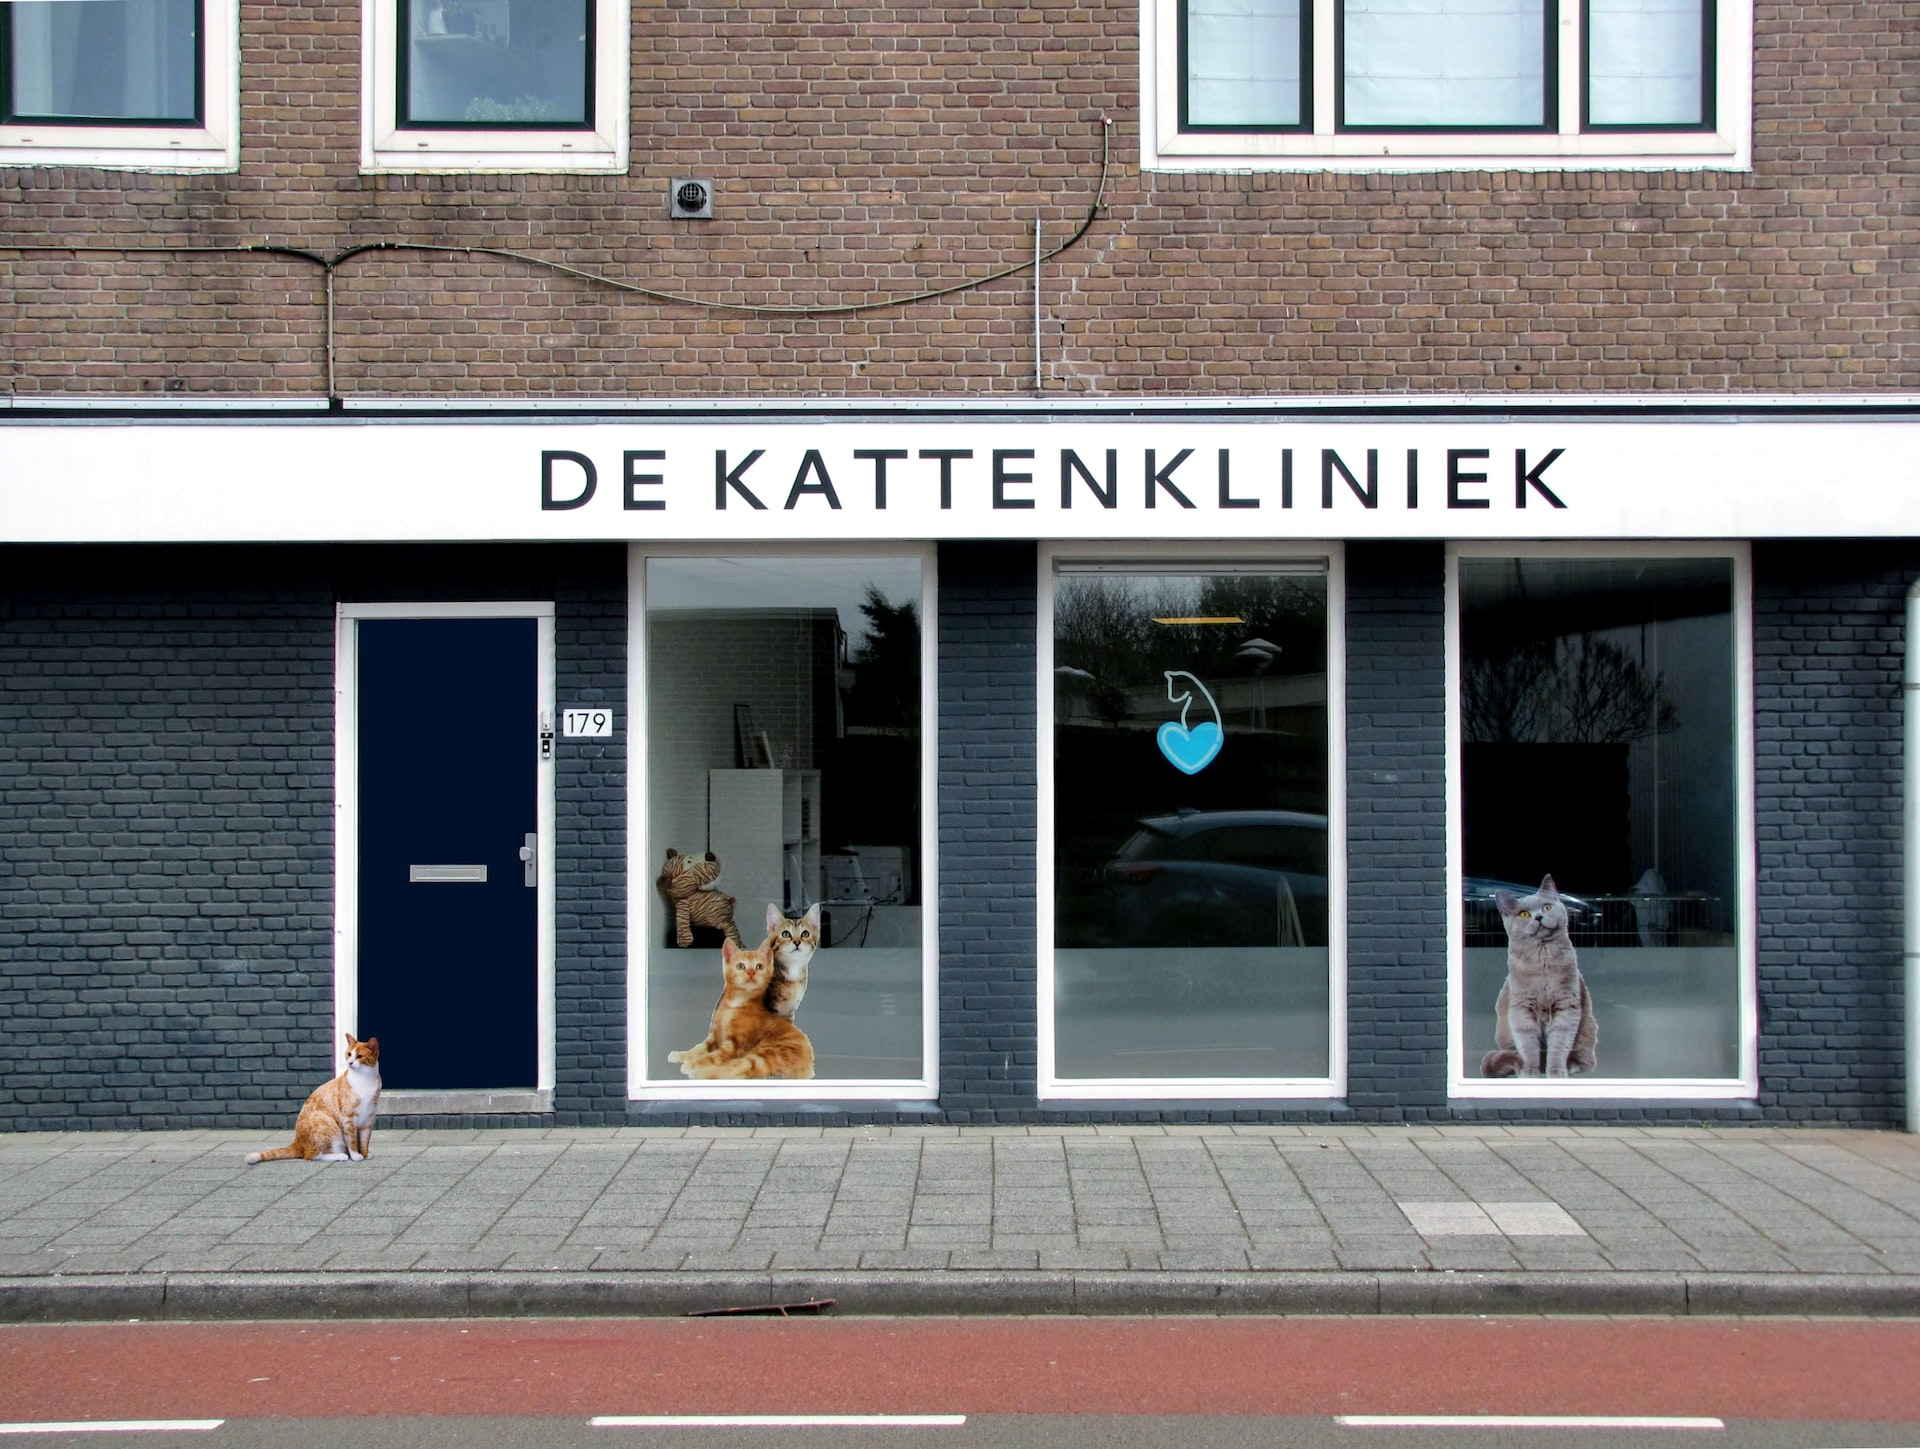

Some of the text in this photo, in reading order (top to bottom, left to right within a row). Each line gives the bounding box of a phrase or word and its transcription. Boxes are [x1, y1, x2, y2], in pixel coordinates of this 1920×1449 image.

[541, 448, 1568, 511] DE KATTENKLINIEK
[568, 713, 606, 733] 179
